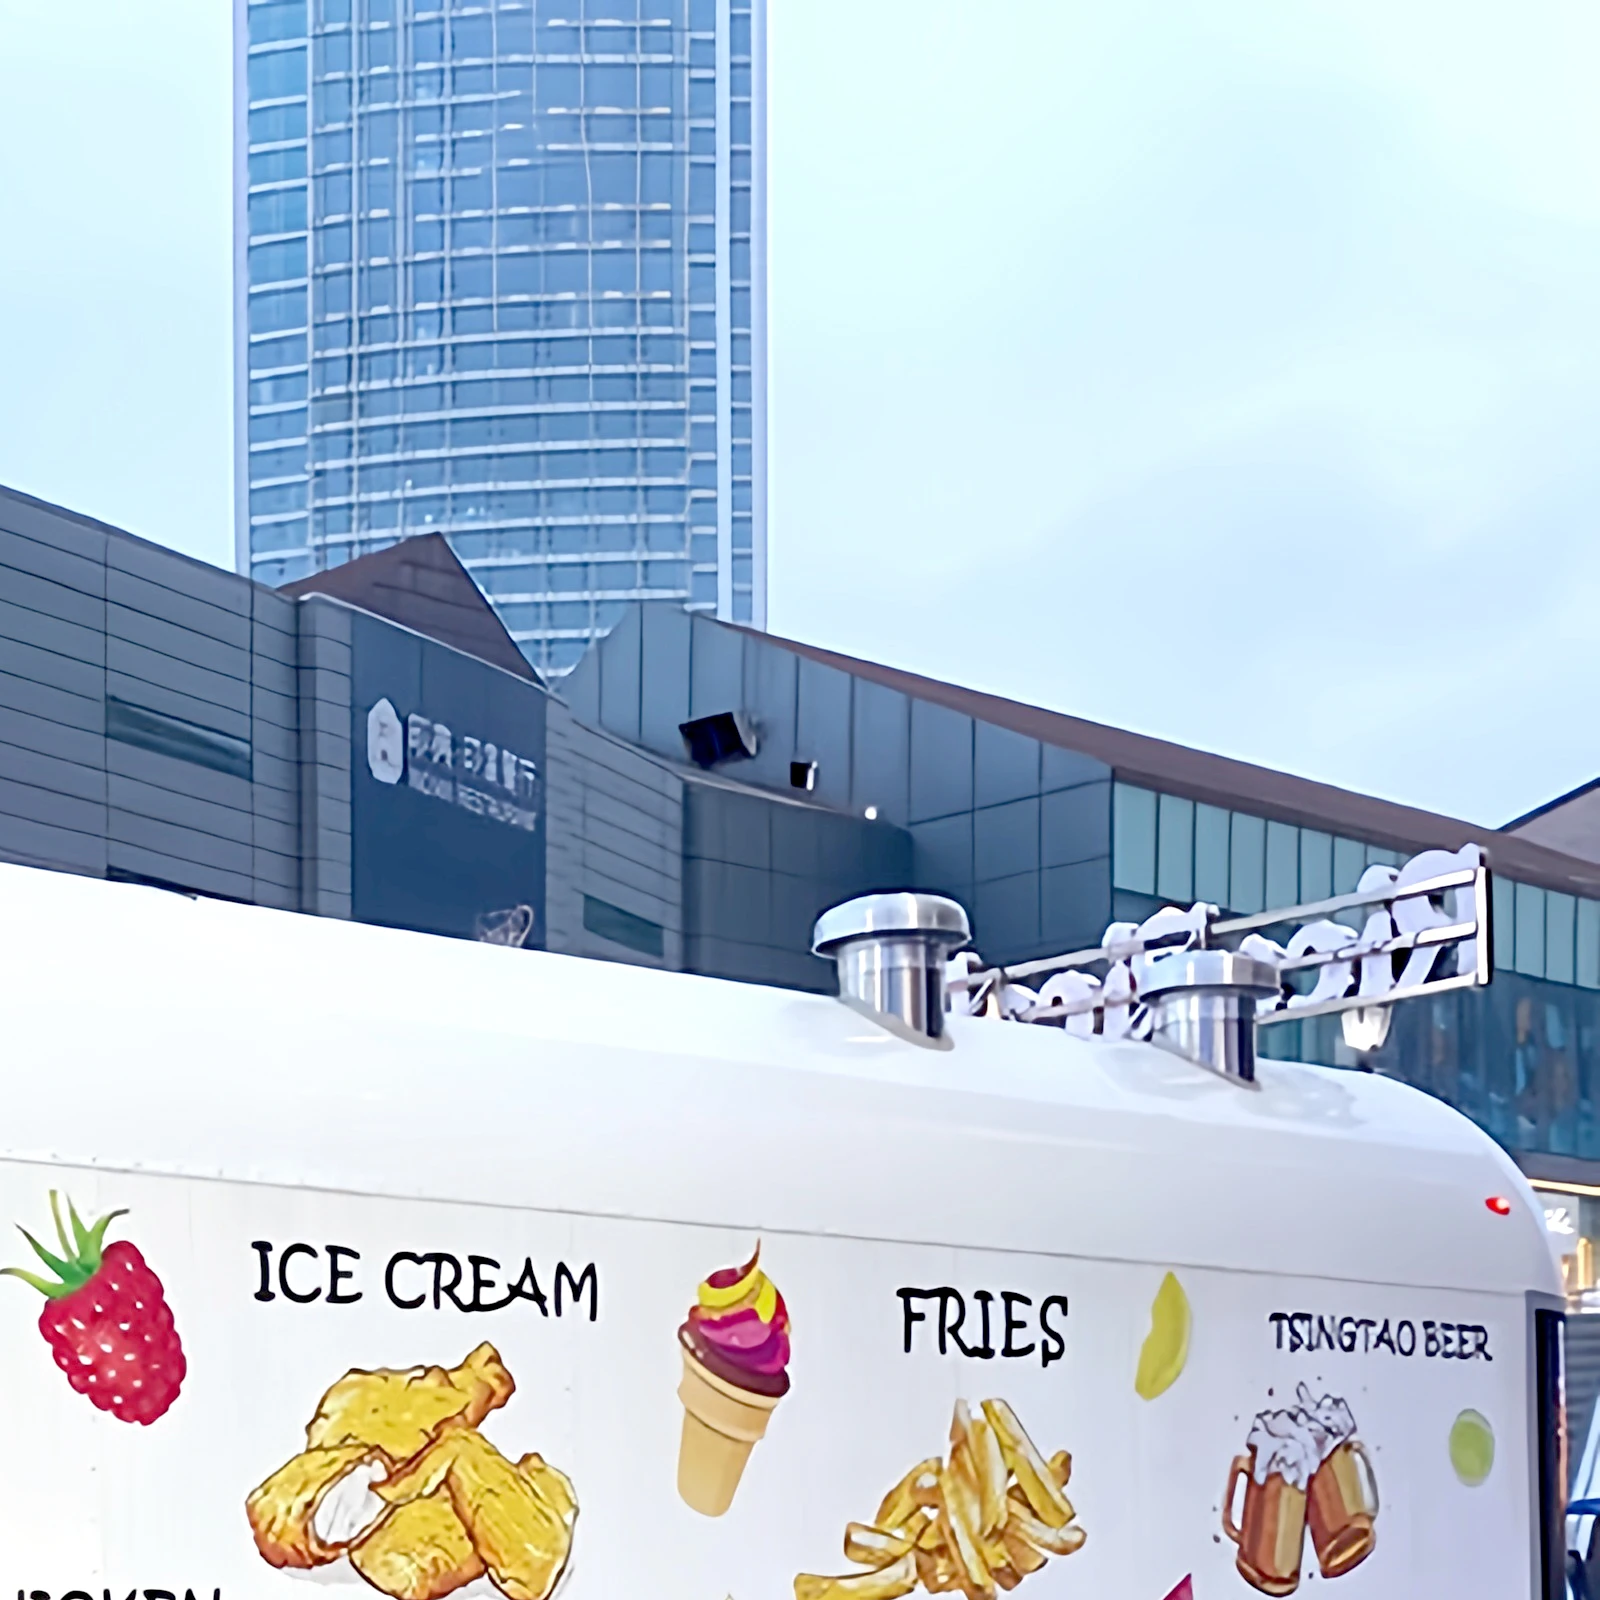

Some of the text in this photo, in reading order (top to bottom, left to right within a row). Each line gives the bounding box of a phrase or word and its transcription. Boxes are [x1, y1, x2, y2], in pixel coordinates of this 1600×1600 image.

[251, 1240, 599, 1322] ICE CREAM
[896, 1286, 1069, 1368] FRIES
[1268, 1312, 1494, 1362] TSINGTAO BEER
